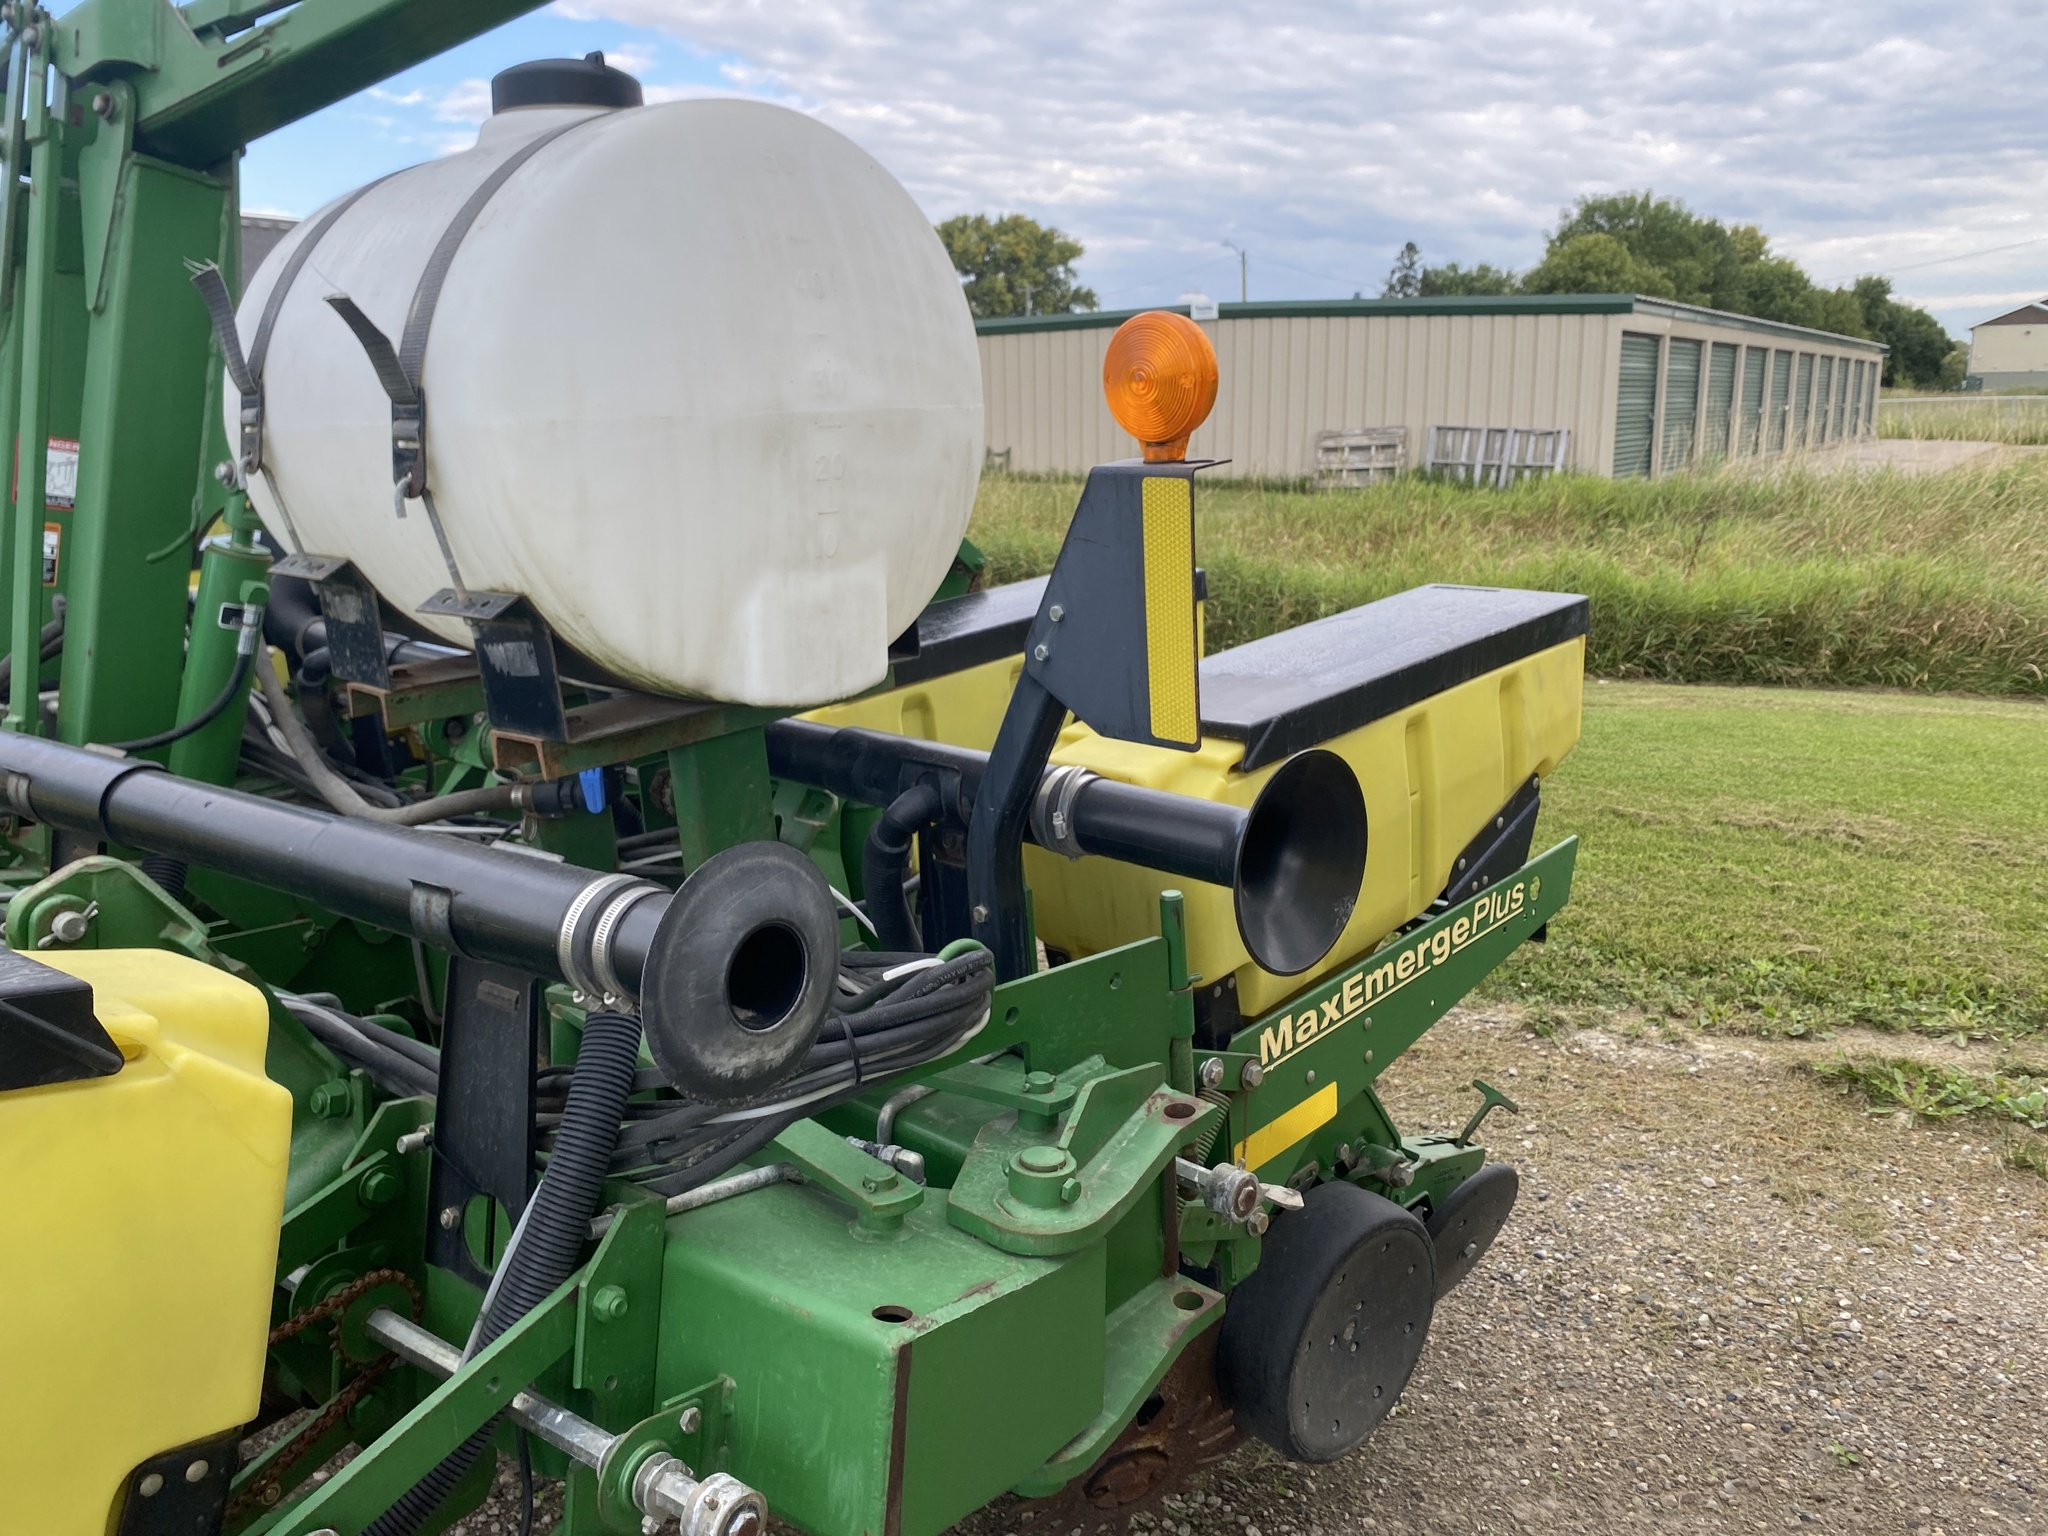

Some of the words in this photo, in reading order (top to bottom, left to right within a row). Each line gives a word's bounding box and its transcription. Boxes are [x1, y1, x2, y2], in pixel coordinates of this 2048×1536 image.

[794, 268, 826, 300] 40
[814, 454, 846, 482] 20
[816, 531, 839, 560] 10
[1260, 882, 1525, 1066] MaxEmergePlus
